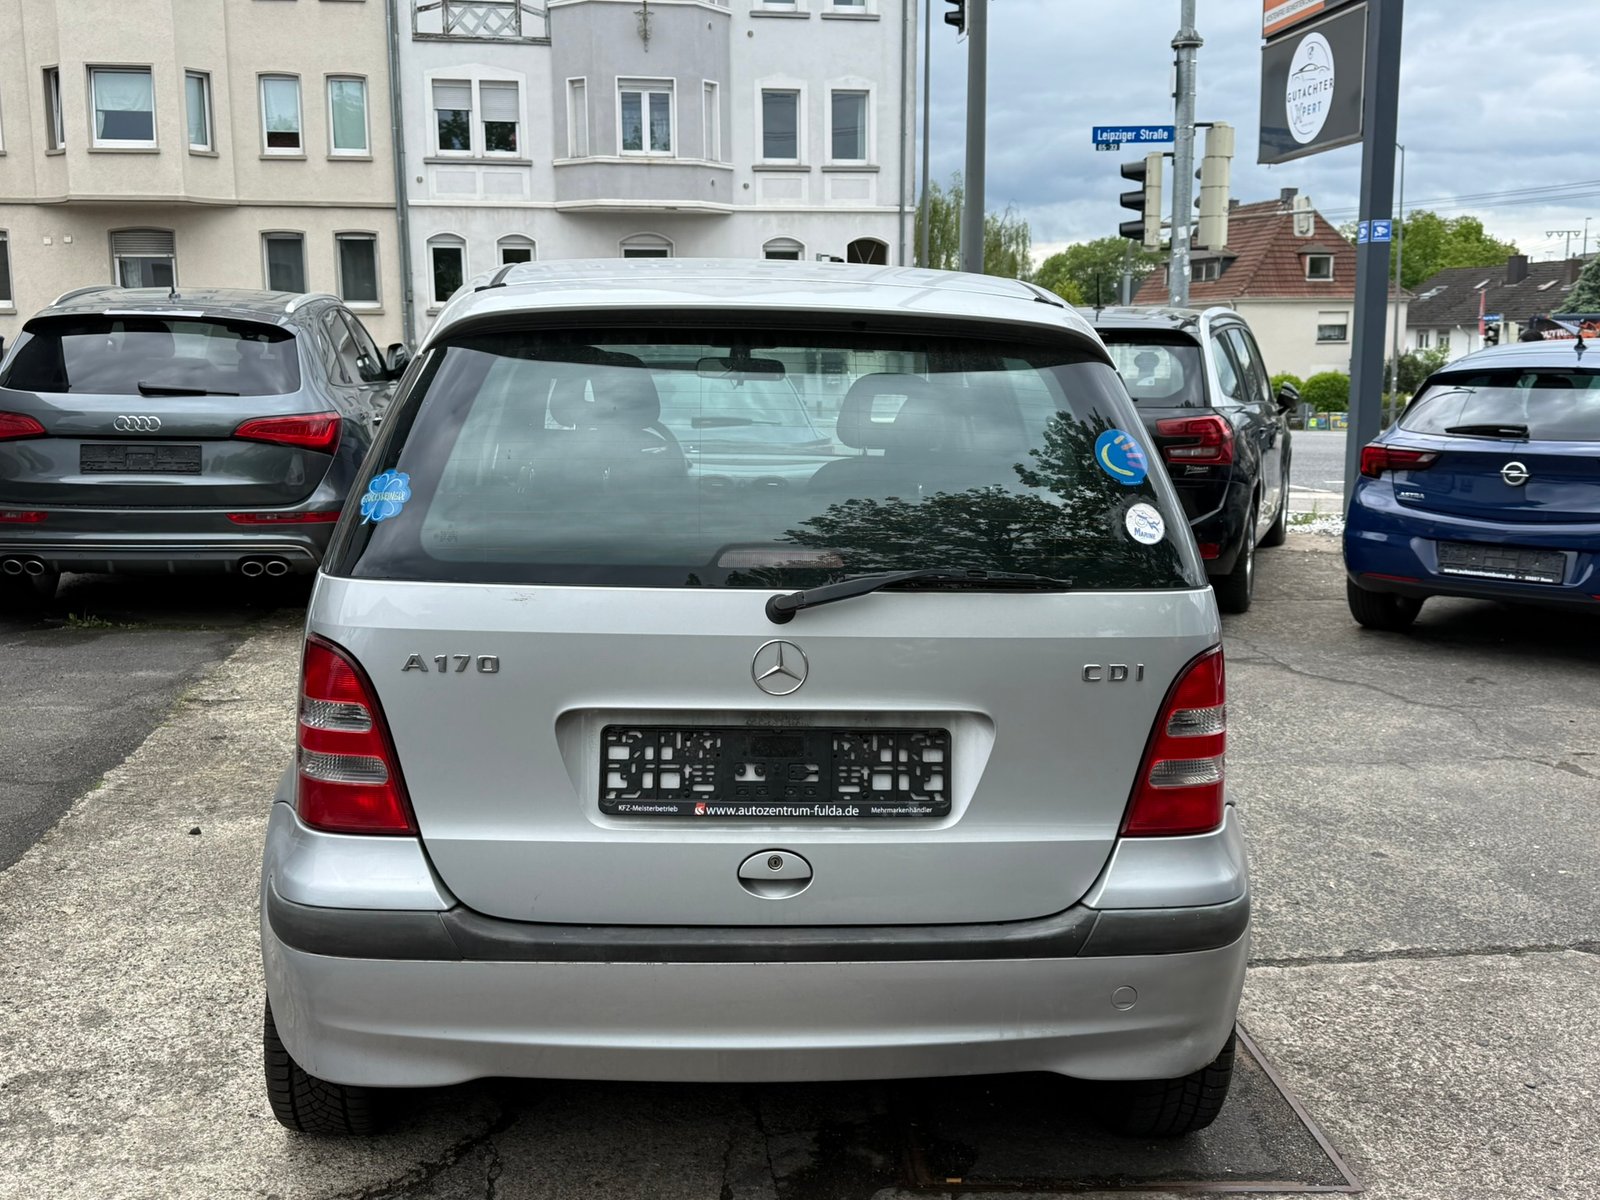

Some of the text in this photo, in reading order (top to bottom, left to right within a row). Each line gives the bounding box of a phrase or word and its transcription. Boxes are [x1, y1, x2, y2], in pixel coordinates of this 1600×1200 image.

[1287, 78, 1334, 103] GUTACHTER
[1097, 128, 1169, 143] Leipziger Straße
[1082, 663, 1144, 682] CDI
[618, 804, 933, 817] KFZ-Meisterbetrieb www.autozentrum-fulda.de Mehrmarkenhändler
